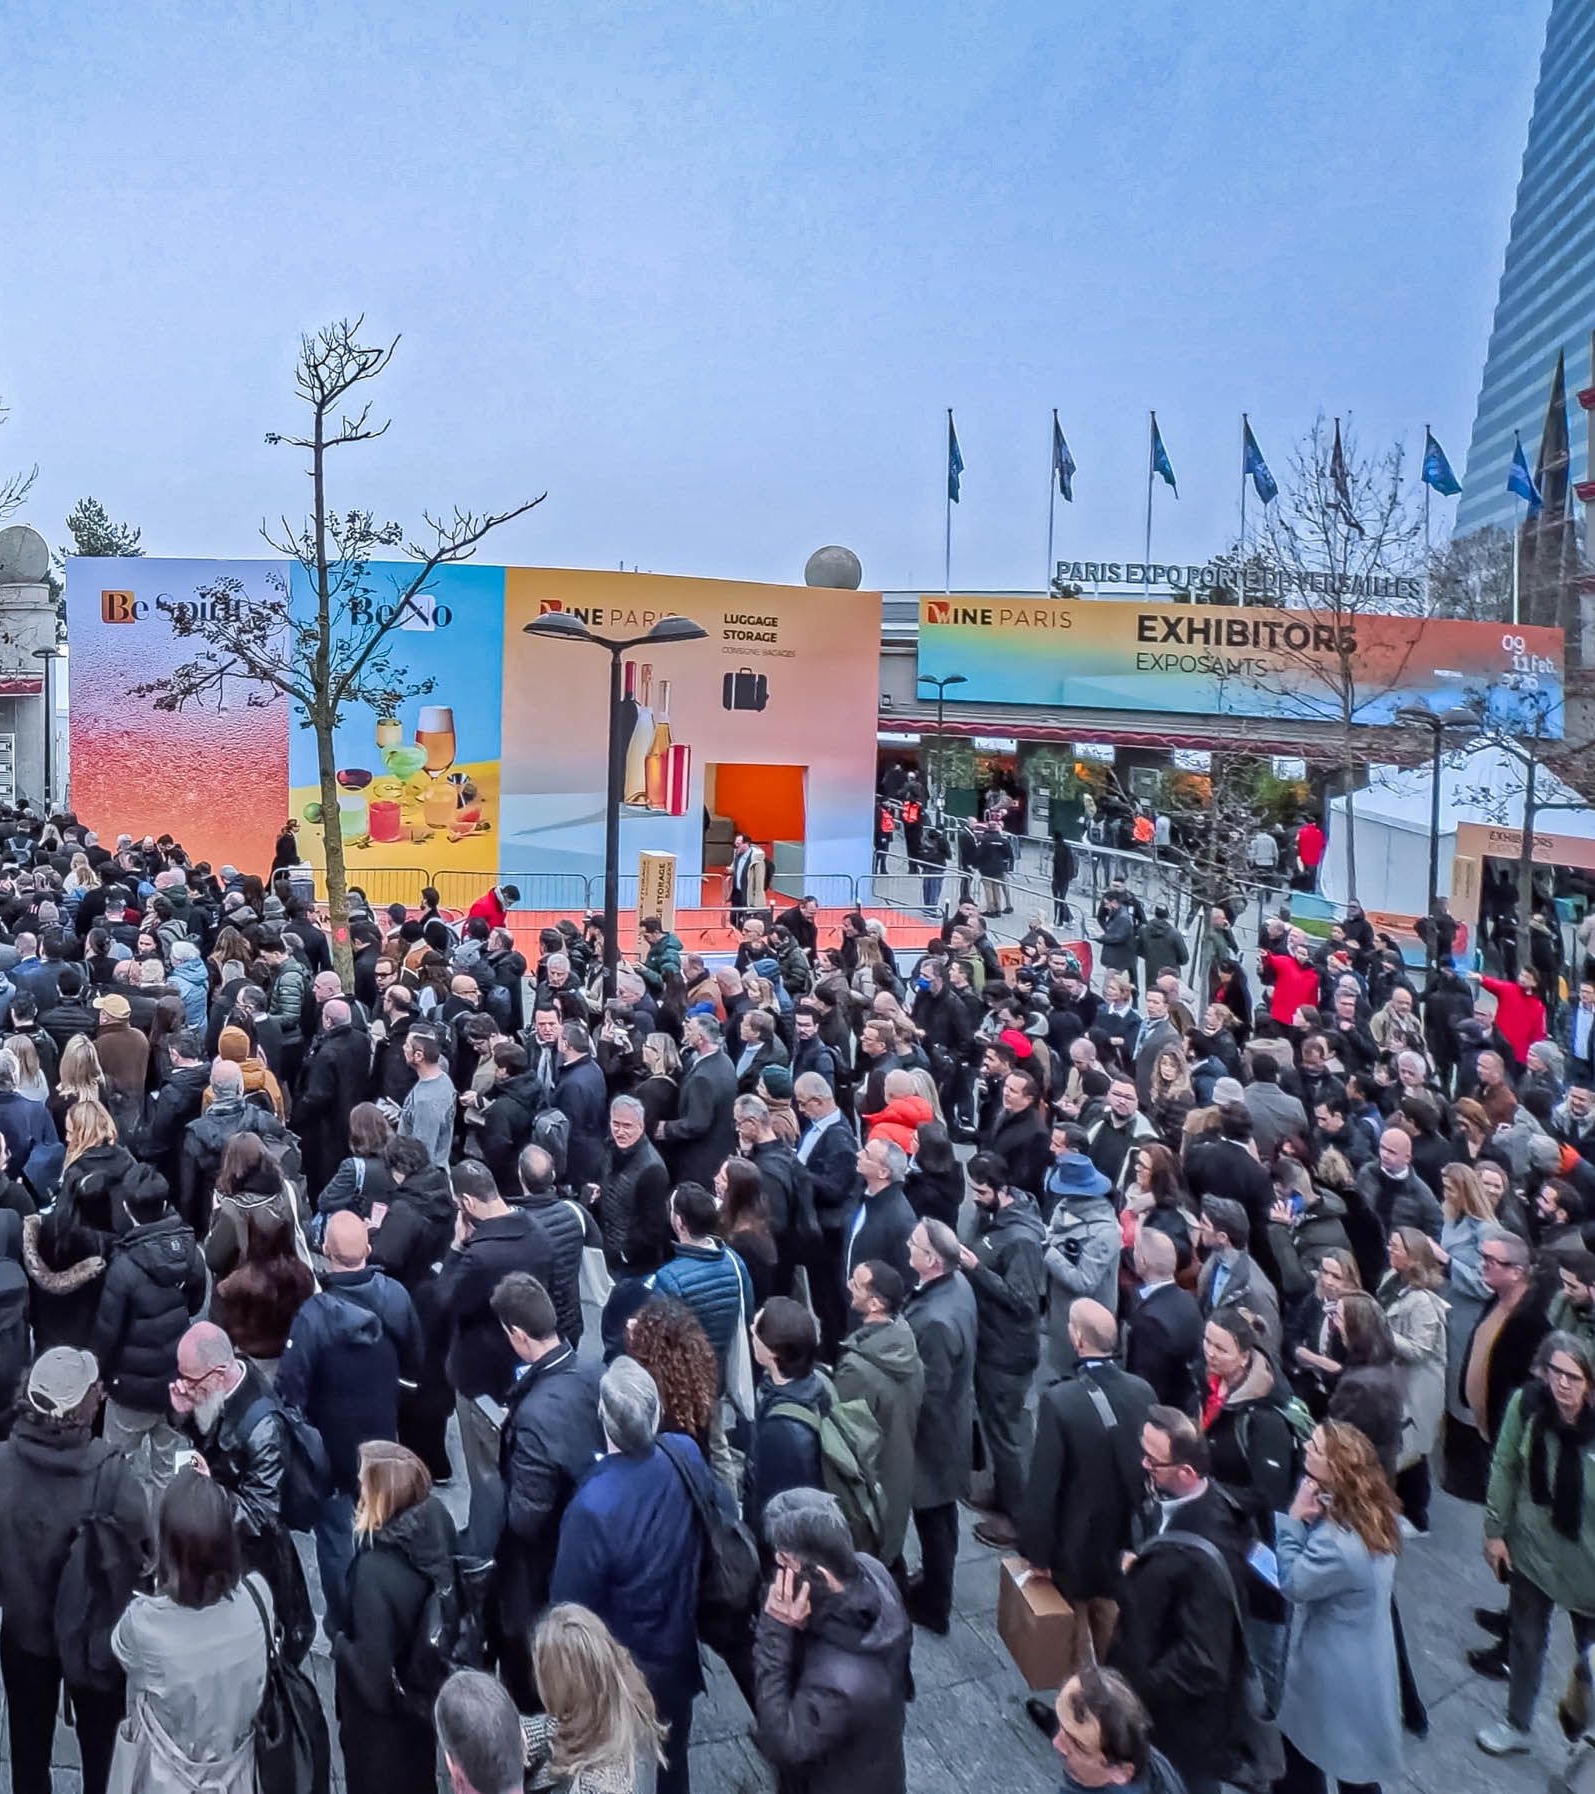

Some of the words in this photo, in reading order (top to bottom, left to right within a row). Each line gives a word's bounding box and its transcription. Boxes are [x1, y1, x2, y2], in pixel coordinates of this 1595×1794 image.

[1056, 560, 1122, 583] PARIS
[1126, 563, 1183, 586] EXPO
[1187, 566, 1256, 590] PORTE
[107, 594, 150, 622] Be
[723, 613, 779, 627] LUGGAGE
[927, 601, 993, 626] WINE
[1000, 608, 1073, 629] PARIS
[722, 629, 778, 643] STORAGE
[1137, 614, 1358, 654] EXHIBITORS
[1501, 634, 1526, 655] 09
[1136, 652, 1269, 678] EXPOSANTS
[1512, 655, 1531, 672] 11
[656, 863, 666, 905] STORAGE
